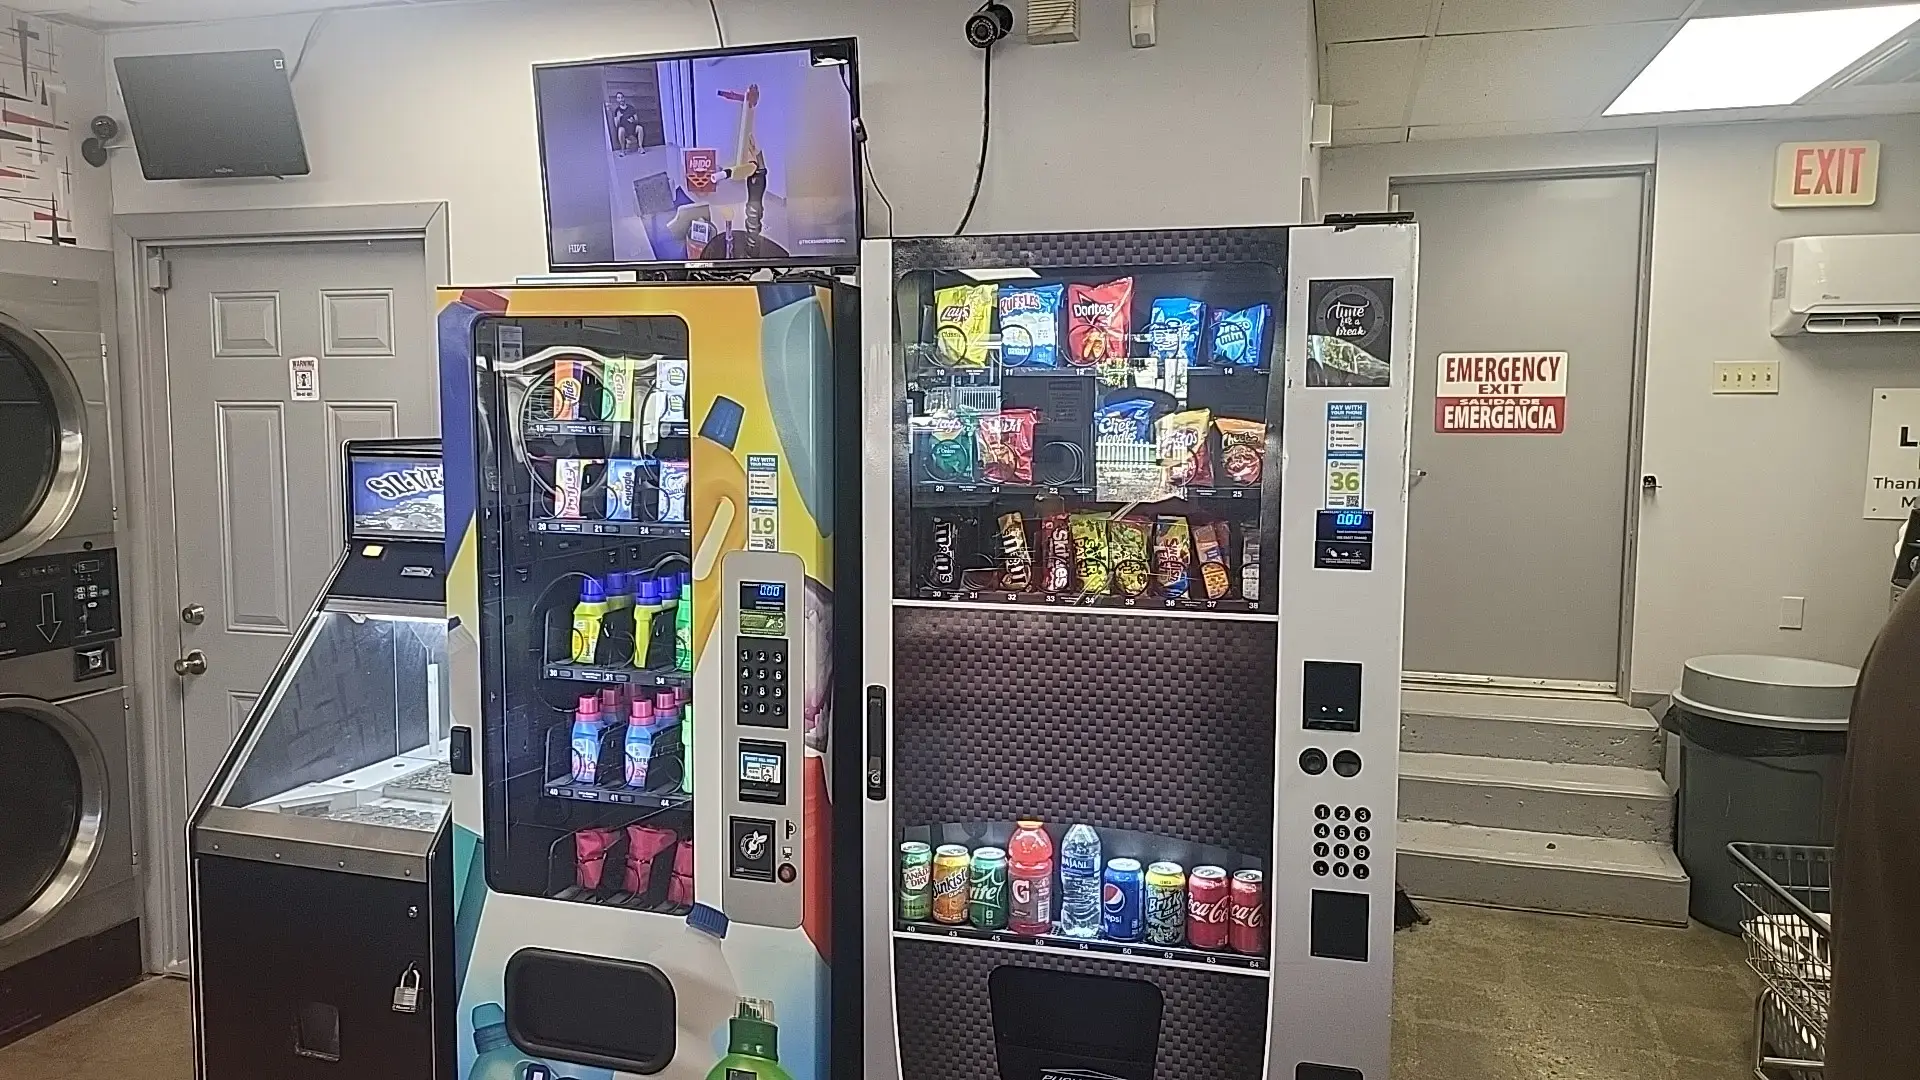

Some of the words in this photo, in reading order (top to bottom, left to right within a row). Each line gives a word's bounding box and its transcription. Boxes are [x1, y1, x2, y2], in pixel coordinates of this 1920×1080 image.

[1793, 148, 1866, 195] EXIT
[1000, 292, 1040, 314] RUFFLES
[1073, 302, 1115, 317] Doritos
[1327, 300, 1370, 319] Time
[940, 304, 971, 323] Lay's
[1336, 326, 1366, 336] break
[1223, 367, 1233, 375] 14
[1446, 356, 1561, 383] EMERGENCY
[563, 380, 577, 401] Tide
[614, 373, 626, 402] Gain
[1478, 384, 1523, 395] EXIT
[1459, 398, 1512, 406] SALIDA
[1444, 405, 1557, 429] EMERGENCIA
[587, 425, 596, 434] 11
[1098, 417, 1138, 434] Cheez
[1900, 426, 1920, 447] L
[1329, 471, 1360, 491] 36
[624, 471, 634, 507] Snuggle
[1232, 490, 1243, 498] 25
[1901, 496, 1918, 508] M
[537, 523, 547, 531] 20
[594, 524, 603, 533] 21
[640, 526, 650, 535] 24
[751, 517, 775, 535] 19
[1074, 537, 1087, 577] PATCH
[1085, 538, 1098, 576] SOUR
[743, 651, 748, 660] 1
[759, 652, 765, 661] 2
[775, 653, 782, 663] 3
[549, 669, 558, 677] 30
[743, 668, 749, 678] 4
[759, 669, 765, 679] 5
[775, 670, 782, 680] 6
[655, 677, 665, 685] 34
[743, 685, 749, 695] 7
[759, 686, 765, 696] 8
[775, 687, 781, 697] 9
[759, 703, 765, 713] 0
[549, 788, 559, 796] 40
[610, 794, 619, 802] 41
[660, 799, 670, 807] 44
[1319, 807, 1325, 818] 1
[1339, 809, 1346, 819] 2
[1359, 810, 1367, 820] 3
[1318, 826, 1326, 836] 4
[1338, 828, 1346, 838] 5
[1359, 829, 1366, 840] 6
[1318, 845, 1325, 856] 7
[1338, 847, 1345, 857] 8
[1358, 848, 1366, 858] 9
[905, 867, 930, 882] ANAD
[1338, 865, 1345, 876] 0
[911, 876, 927, 887] DRY
[970, 883, 998, 900] rite
[1012, 879, 1031, 904] G
[1148, 891, 1181, 913] Brisk
[1187, 892, 1229, 924] oca-Co
[1103, 911, 1122, 924] pepsi
[1035, 938, 1044, 946] 50
[1249, 960, 1259, 968] 64
